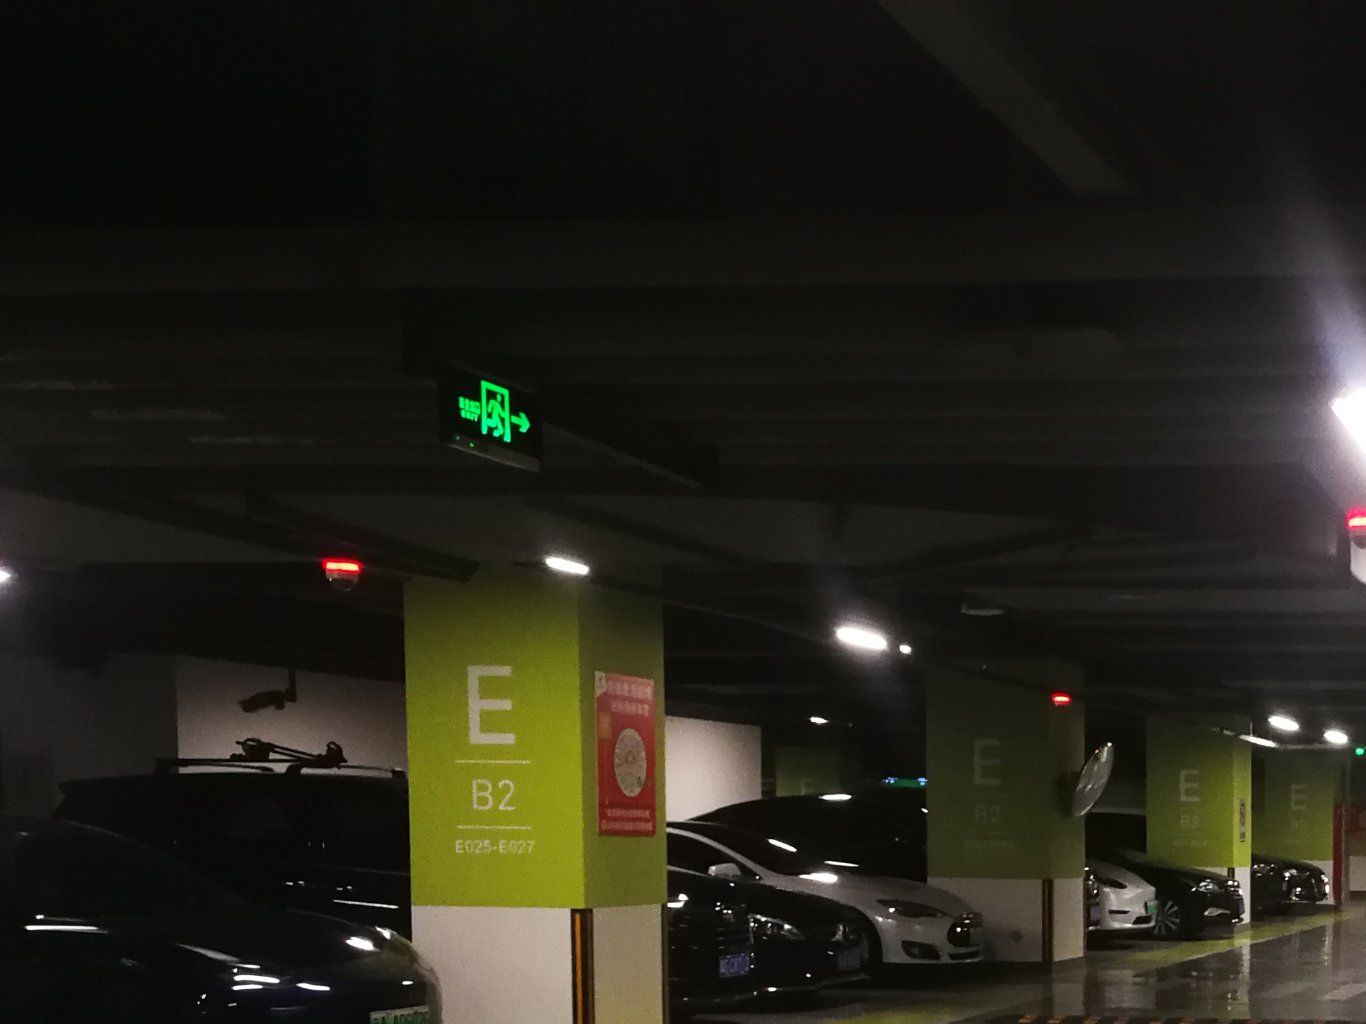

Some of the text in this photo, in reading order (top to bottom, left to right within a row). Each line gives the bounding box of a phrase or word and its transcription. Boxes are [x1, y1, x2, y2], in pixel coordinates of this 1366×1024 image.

[467, 665, 515, 744] E
[973, 739, 1002, 785] E
[472, 779, 516, 811] B2
[1179, 769, 1201, 802] E
[455, 840, 536, 854] E025-E027
